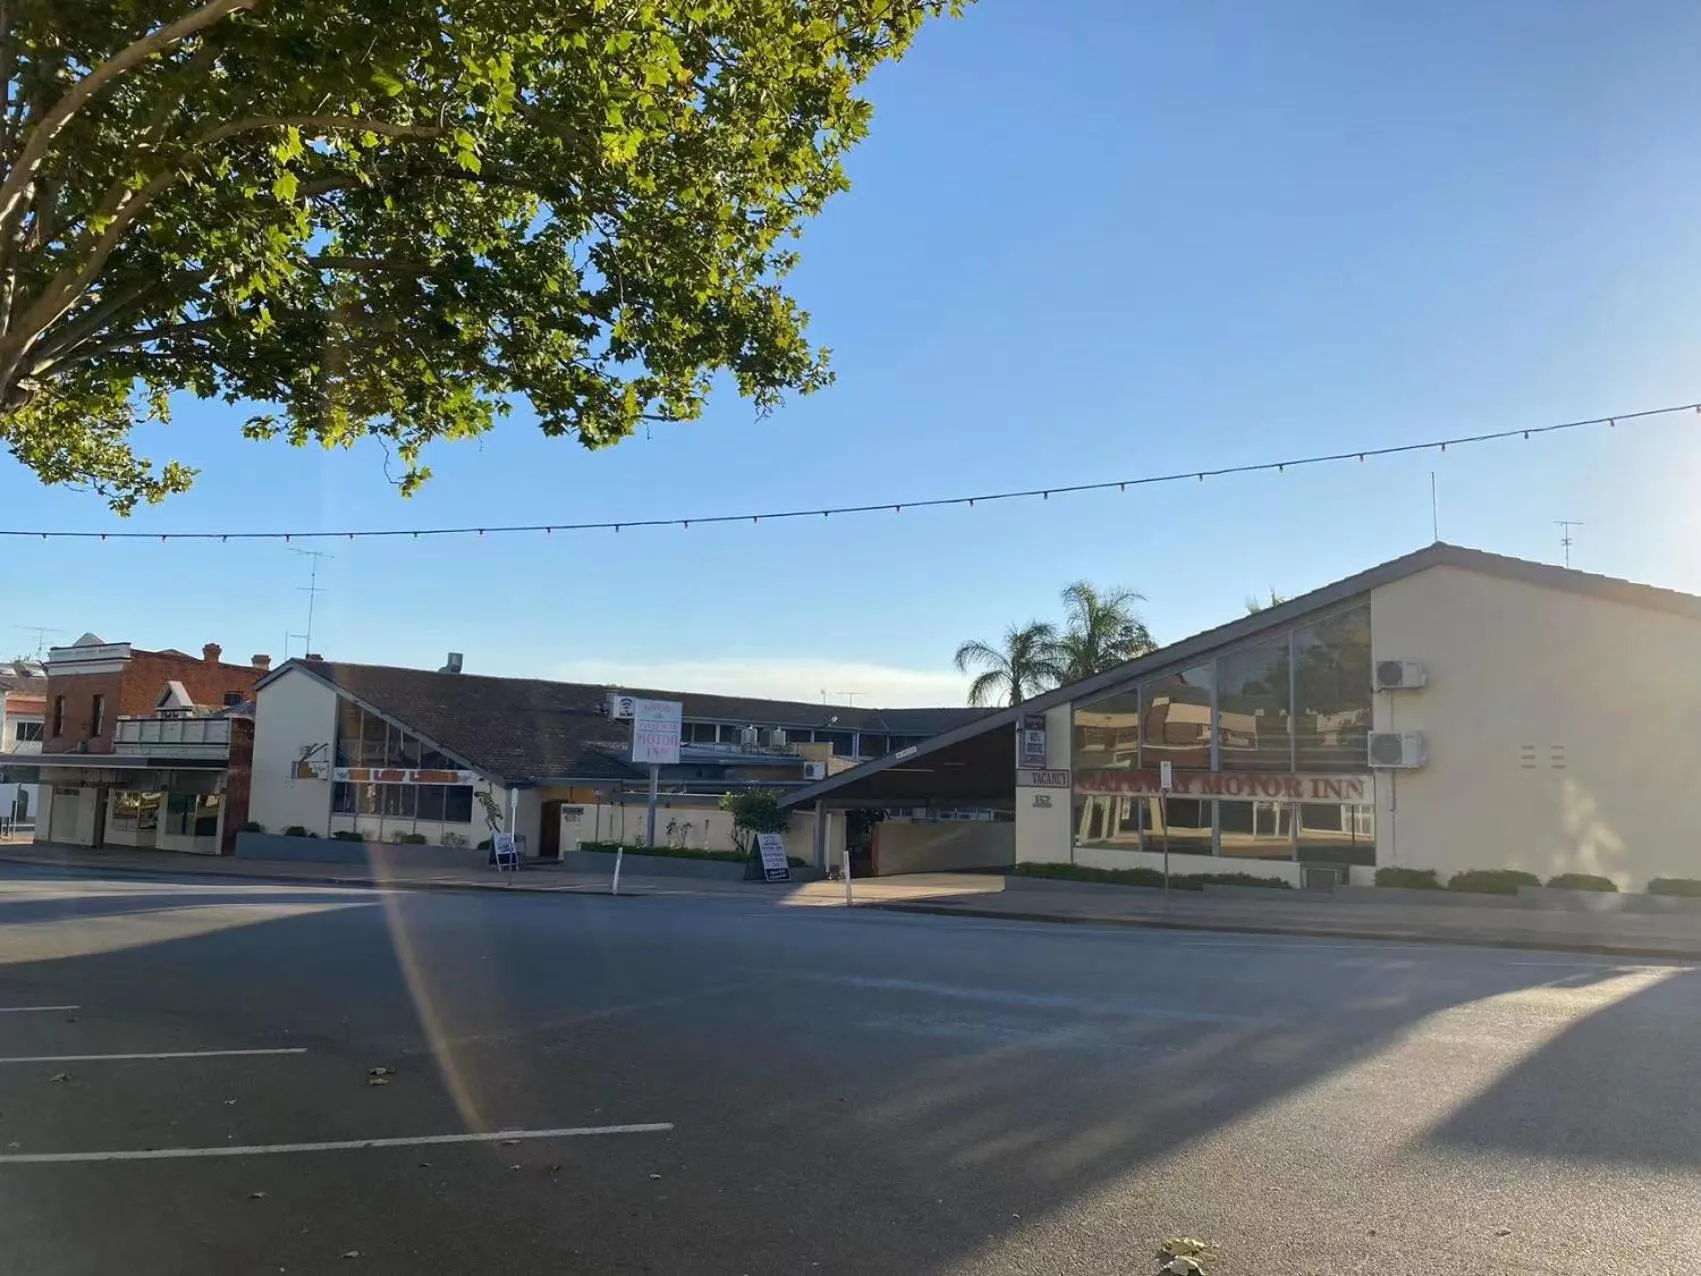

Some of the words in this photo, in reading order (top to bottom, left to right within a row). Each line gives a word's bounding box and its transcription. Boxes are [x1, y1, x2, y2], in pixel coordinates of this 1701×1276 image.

[1032, 771, 1068, 785] VACANCY
[1200, 775, 1303, 798] MOTOR
[1309, 779, 1364, 800] INN
